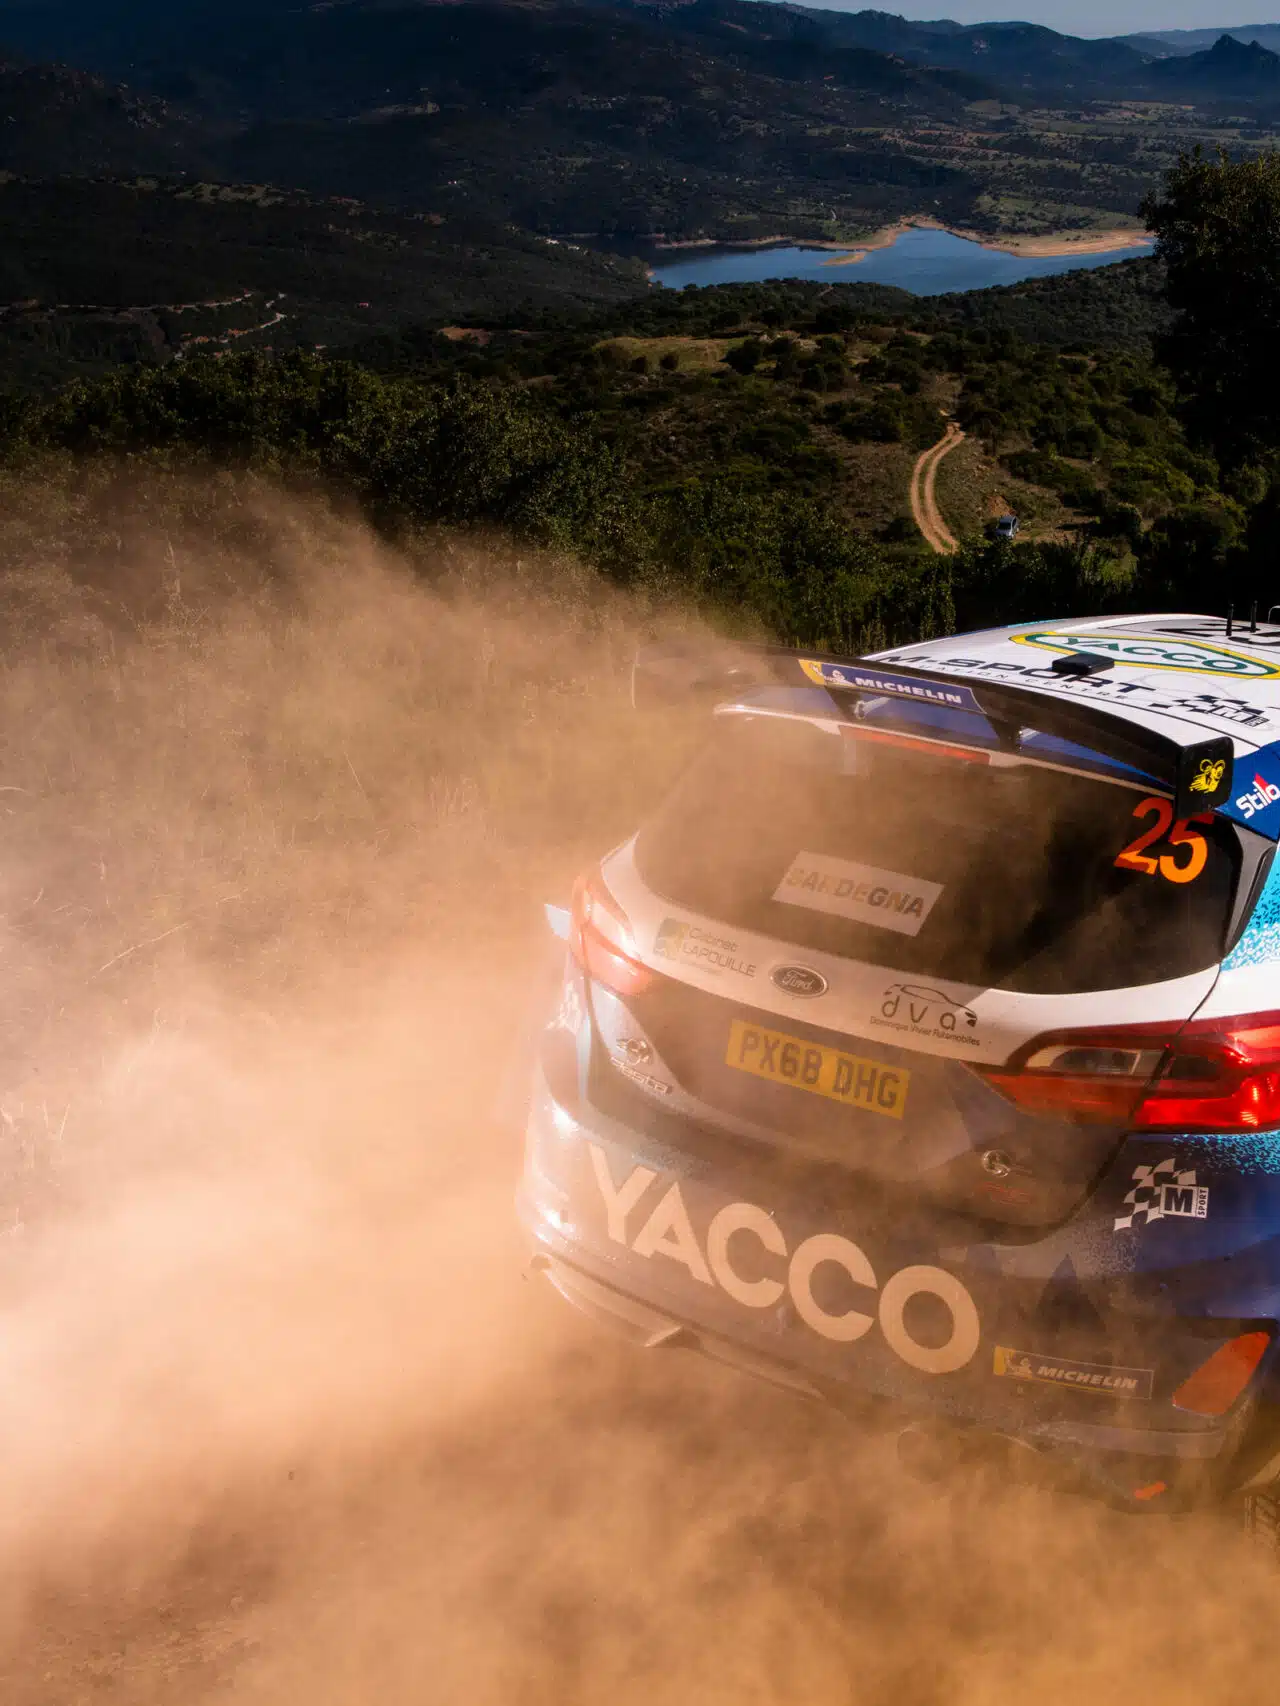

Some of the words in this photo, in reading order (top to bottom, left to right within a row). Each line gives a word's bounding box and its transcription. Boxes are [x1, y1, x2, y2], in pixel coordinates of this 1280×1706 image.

[1064, 637, 1248, 671] YACCO
[855, 677, 962, 704] MICHELIN
[1113, 796, 1215, 884] 25
[781, 968, 815, 991] Ford
[740, 1029, 823, 1085] PX68
[832, 1057, 901, 1109] DHG
[1164, 1186, 1195, 1214] M
[1197, 1188, 1208, 1216] SPORT
[586, 1141, 981, 1375] YACCO
[1037, 1365, 1139, 1390] MICHELIN
